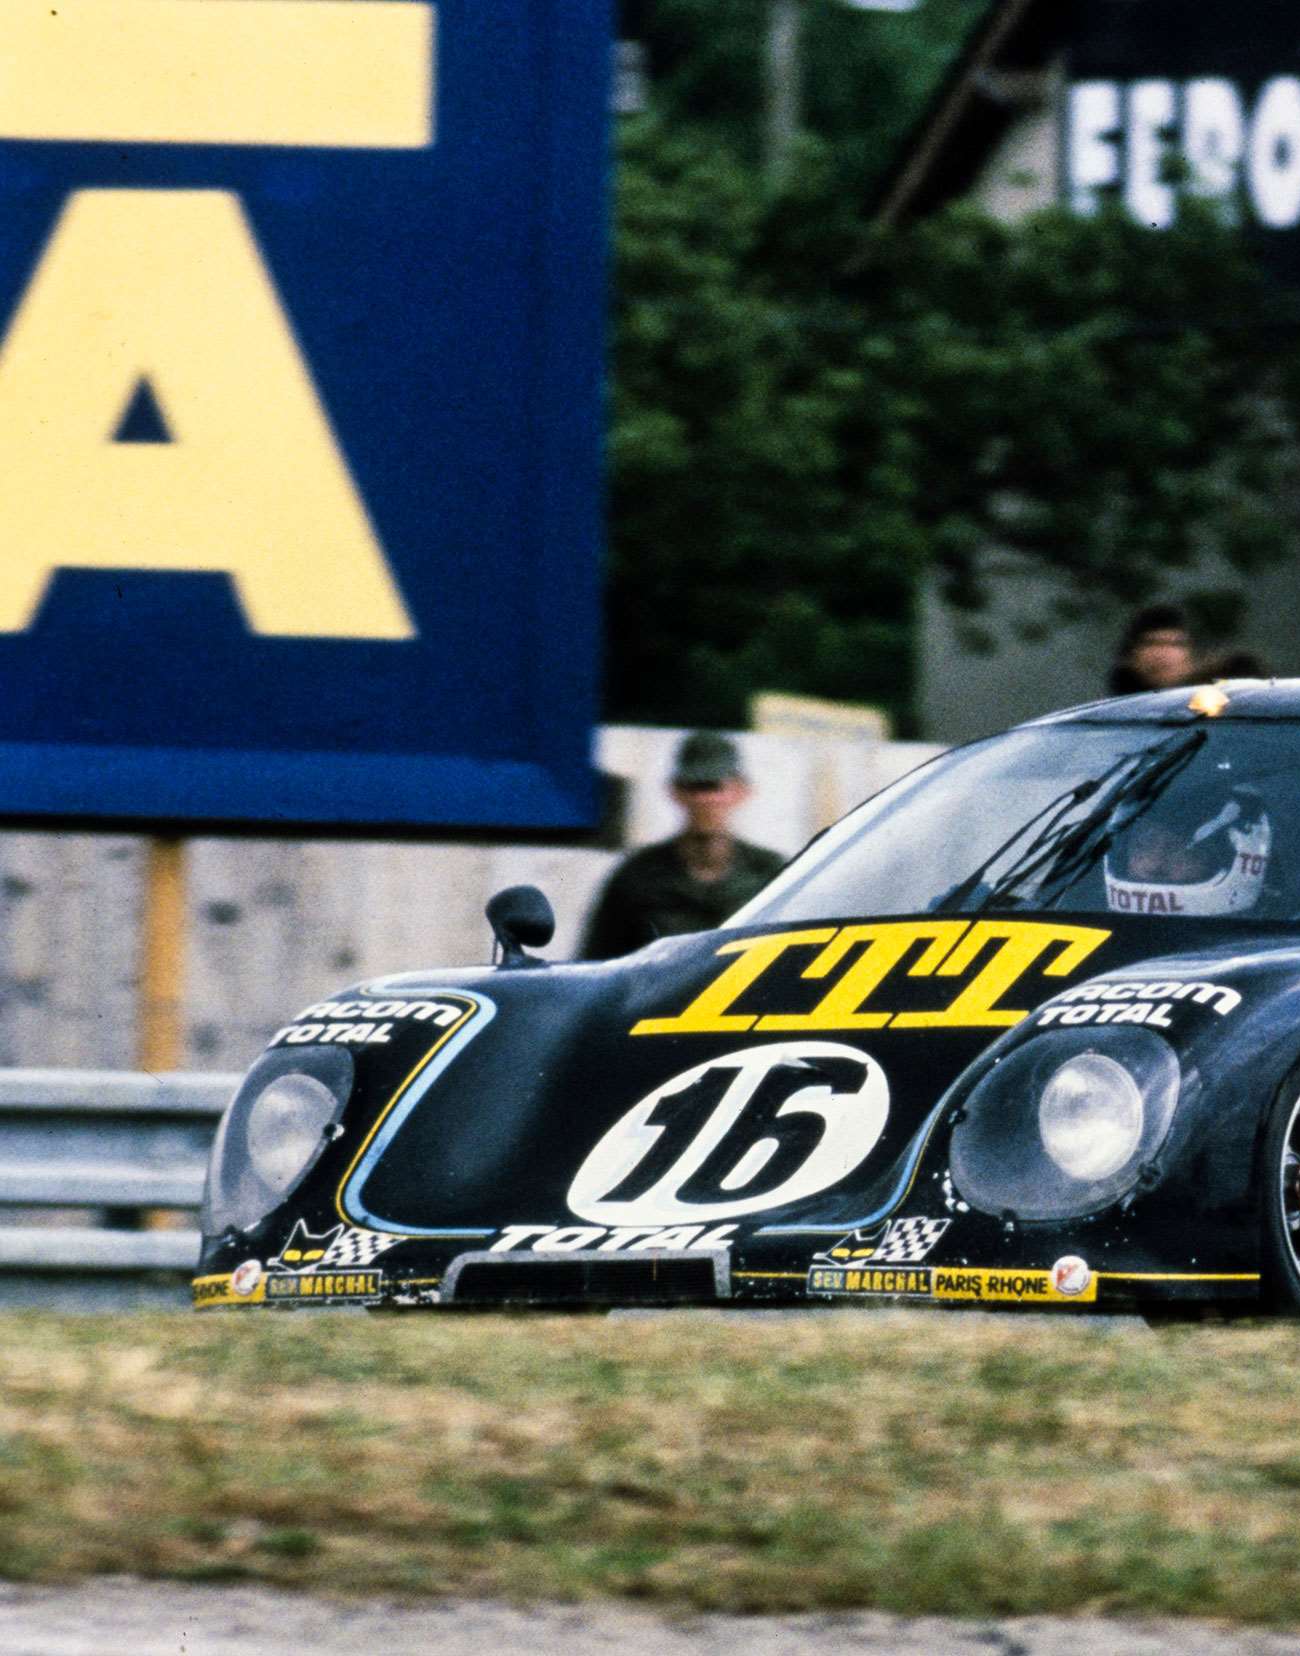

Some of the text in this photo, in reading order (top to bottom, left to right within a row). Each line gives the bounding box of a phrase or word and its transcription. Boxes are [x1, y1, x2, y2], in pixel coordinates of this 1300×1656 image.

[1109, 886, 1183, 912] TOTAL
[1037, 1003, 1172, 1027] TOTAL
[267, 1023, 394, 1049] TOTAL
[597, 1056, 868, 1204] 16
[489, 1225, 740, 1252] TOTAL
[301, 1274, 377, 1297] MARCHAL
[811, 1269, 929, 1291] SEV MARCHAL
[935, 1275, 1048, 1295] PARIS RHONE
